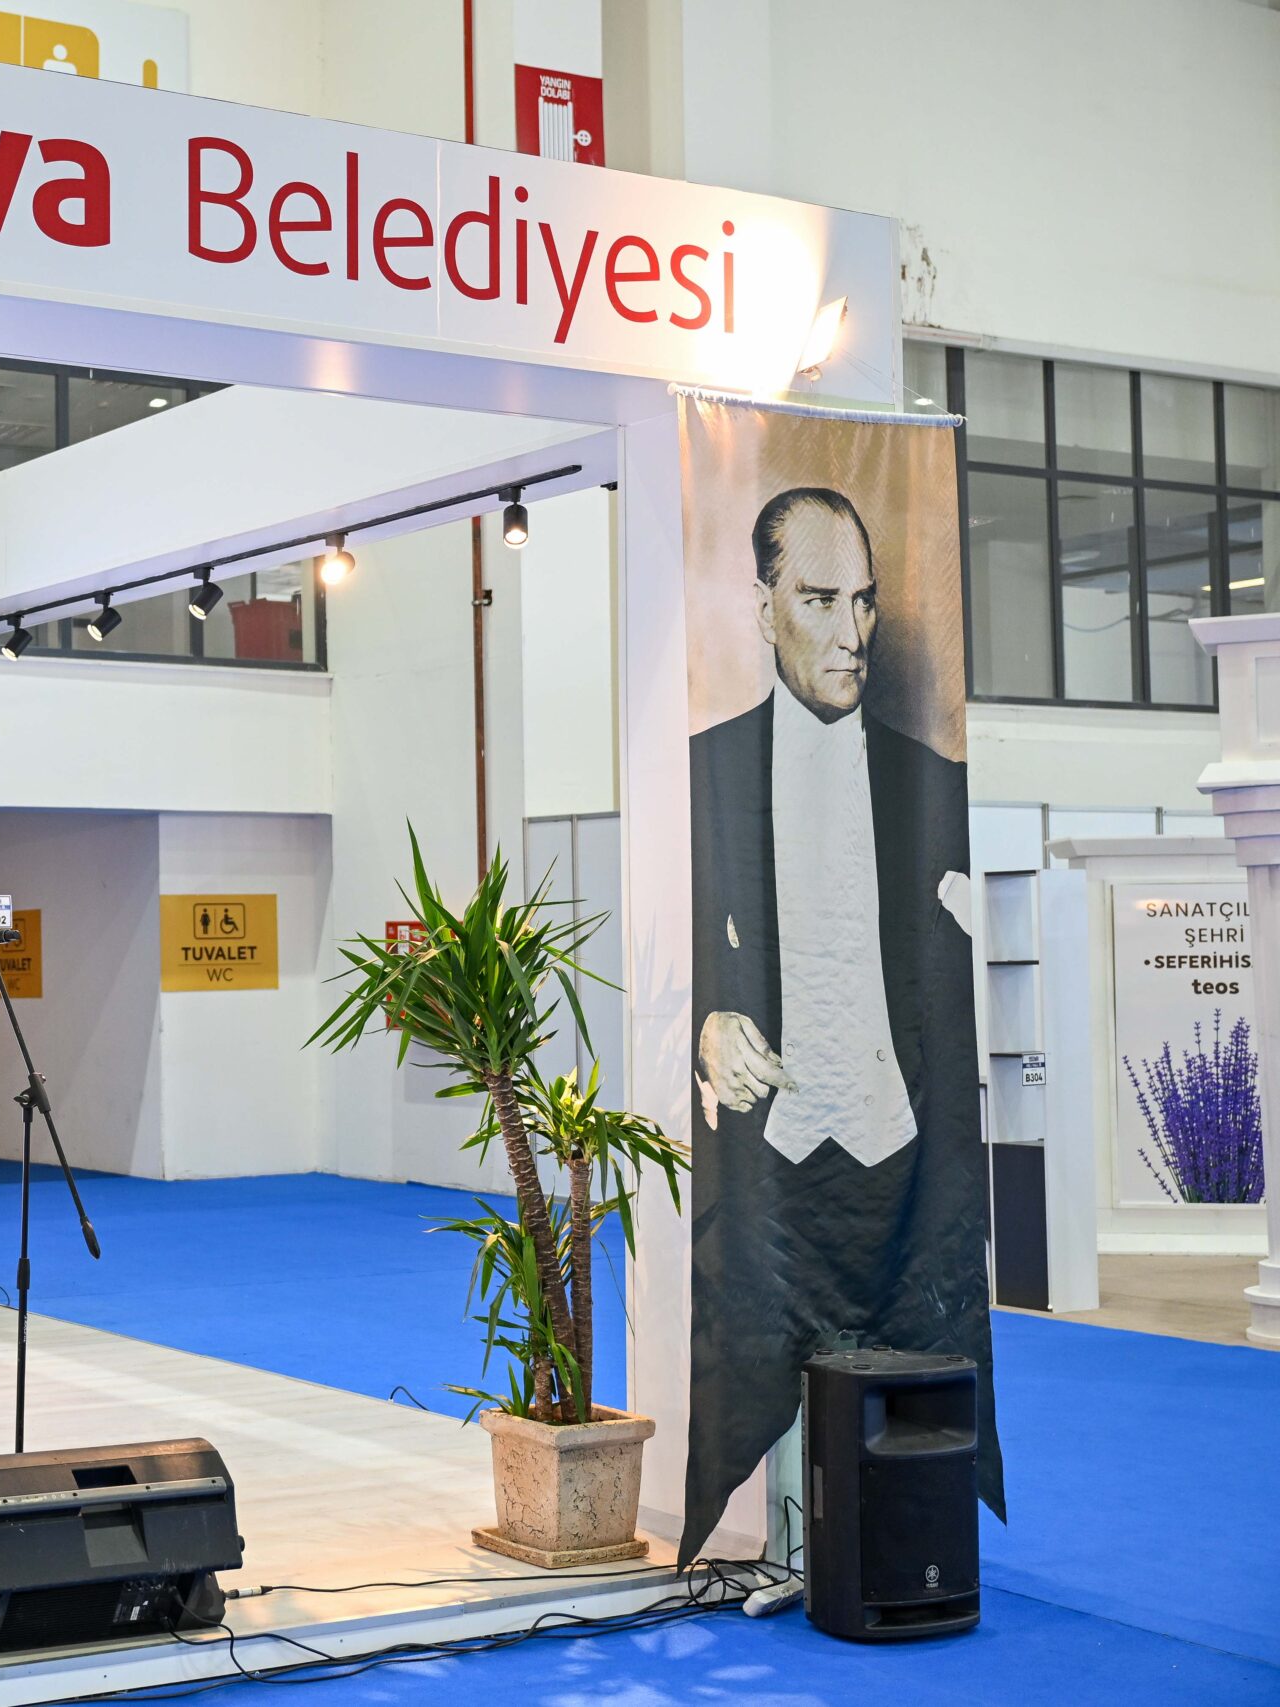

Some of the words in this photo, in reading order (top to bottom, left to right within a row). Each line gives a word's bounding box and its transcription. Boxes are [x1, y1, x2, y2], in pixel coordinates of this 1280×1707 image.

[540, 75, 571, 90] YANGIN
[540, 86, 571, 100] DOLABI
[188, 136, 735, 344] Belediyesi
[1185, 924, 1245, 948] ŞEHRİ
[181, 946, 257, 961] TUVALET
[1154, 952, 1252, 969] SEFERİHİS
[206, 967, 234, 982] WC
[1192, 979, 1240, 995] teos
[1025, 1073, 1043, 1083] B304
